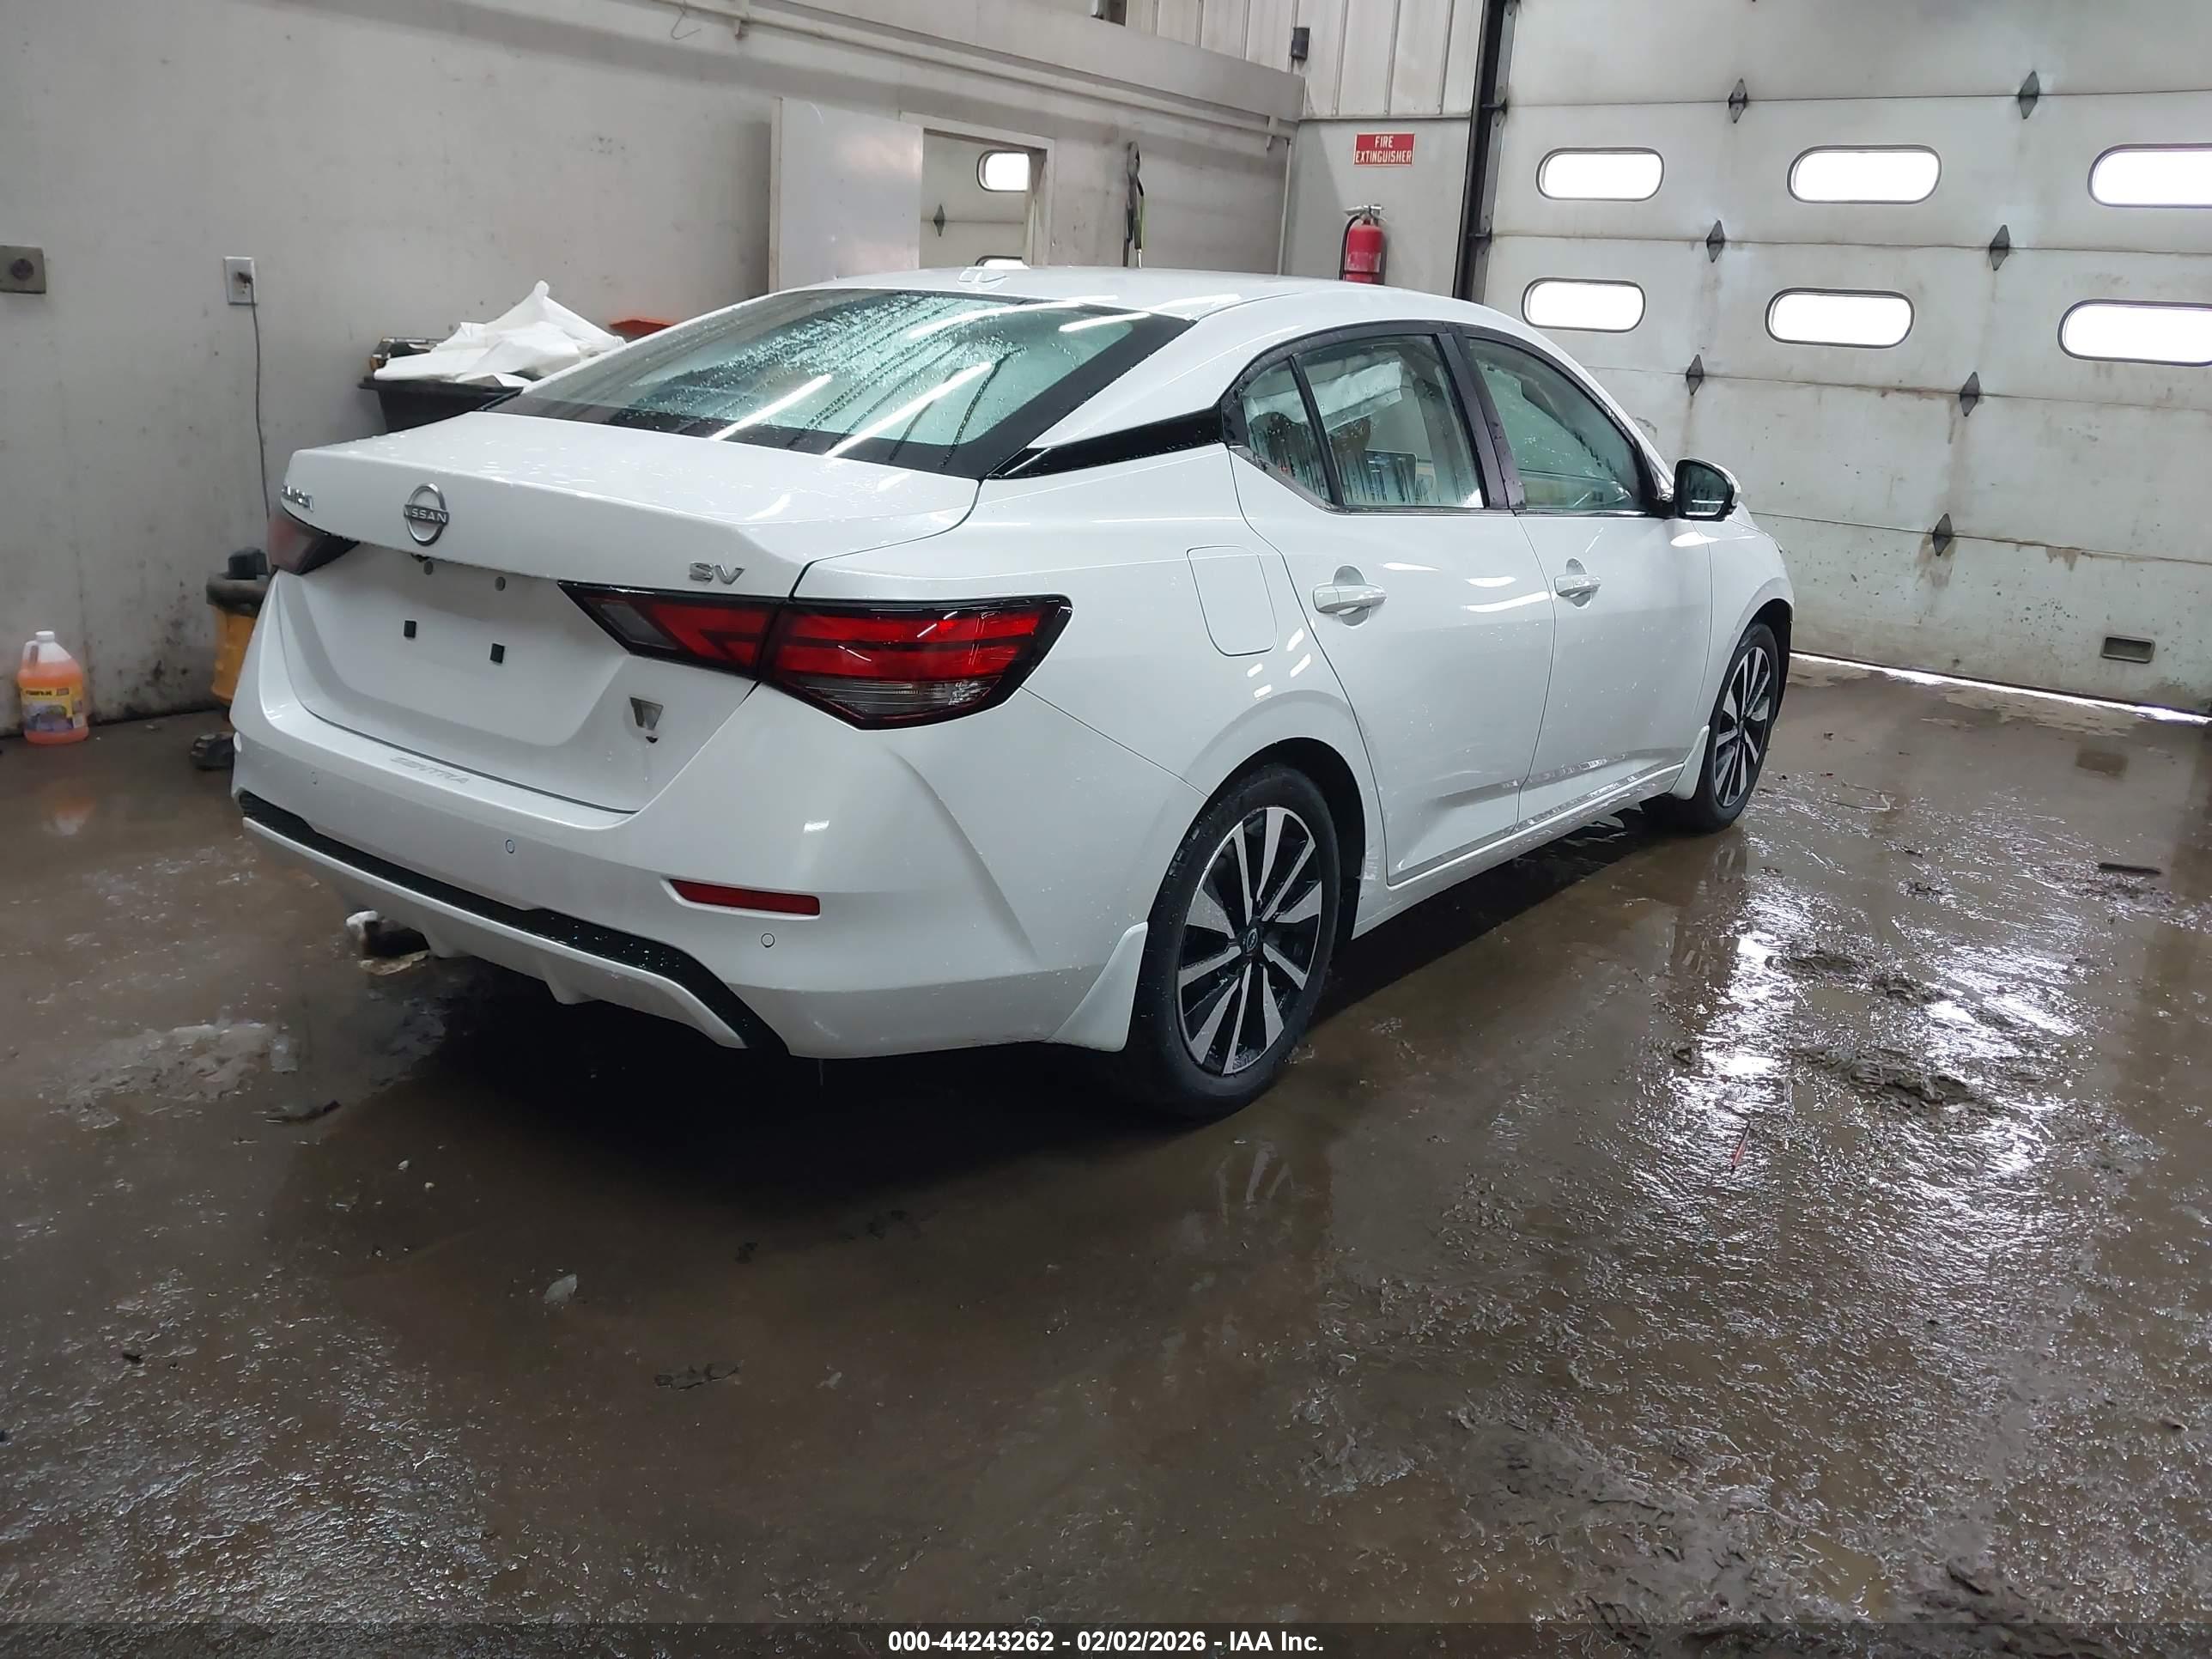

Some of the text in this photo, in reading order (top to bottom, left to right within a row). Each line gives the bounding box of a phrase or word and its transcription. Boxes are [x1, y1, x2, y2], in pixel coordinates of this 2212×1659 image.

[1375, 135, 1394, 148] FIRE
[1355, 149, 1413, 163] EXTINGUISHER
[404, 507, 447, 523] NSSAN
[689, 562, 745, 585] SV
